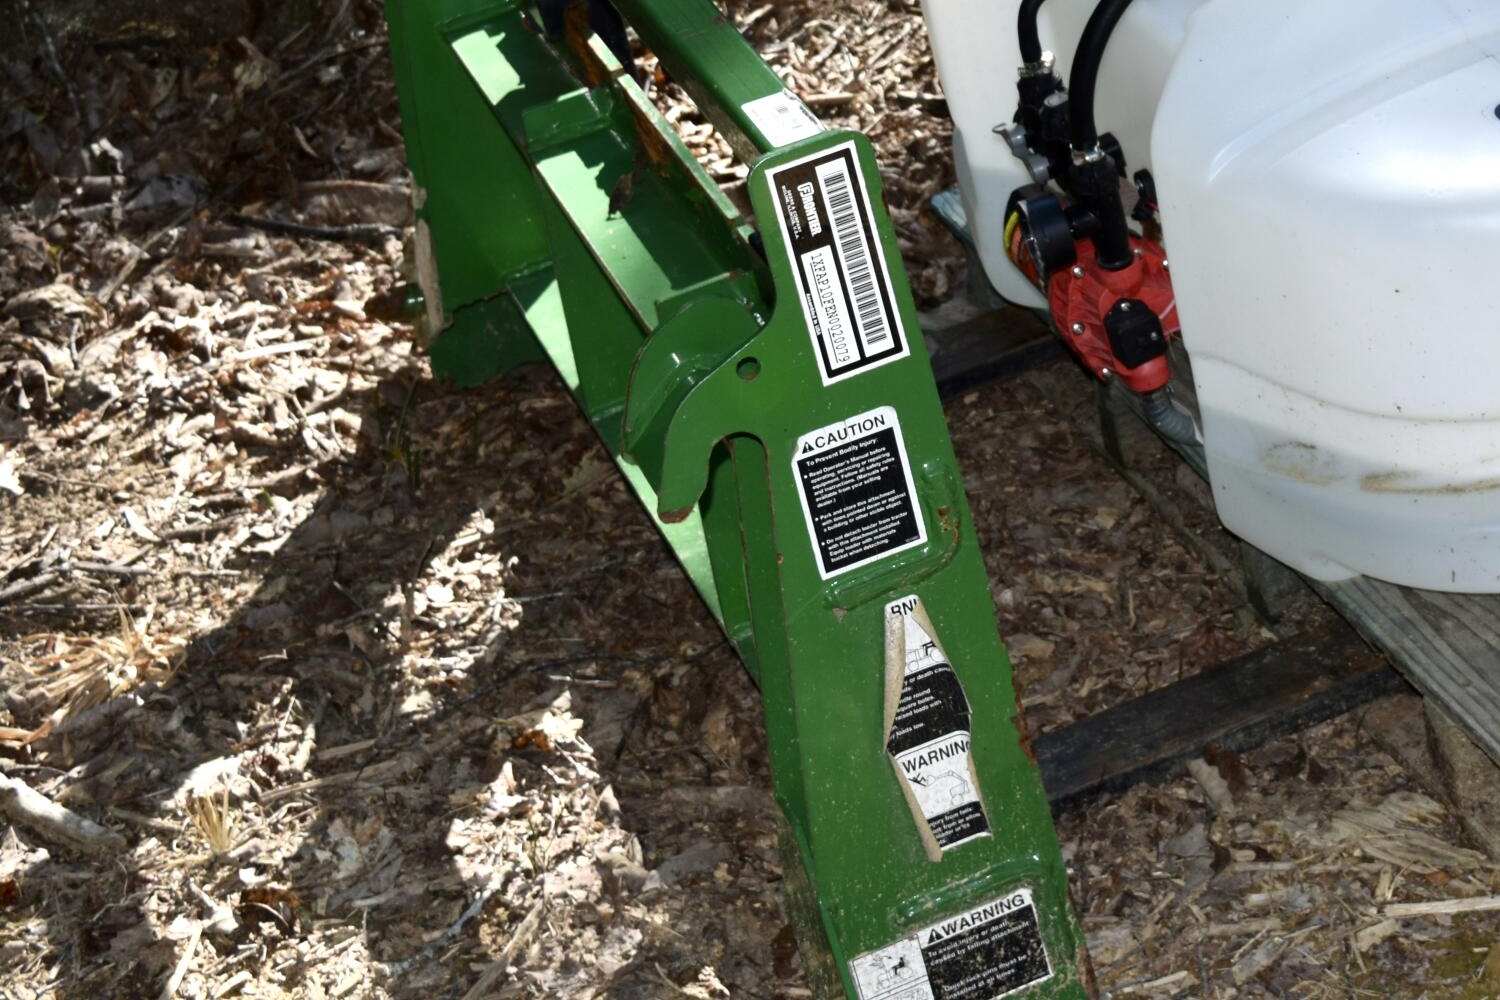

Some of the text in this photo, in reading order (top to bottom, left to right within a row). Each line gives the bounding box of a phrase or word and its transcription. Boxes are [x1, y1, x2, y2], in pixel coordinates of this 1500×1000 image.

[797, 182, 821, 236] FRONTIER
[814, 414, 886, 448] CAUTION
[808, 469, 822, 477] Read
[850, 452, 869, 462] Manual
[869, 447, 886, 455] before
[814, 451, 838, 463] Prevent
[838, 445, 858, 455] Bodily
[917, 671, 933, 680] death
[913, 688, 930, 698] round
[941, 894, 1025, 936] WARNING
